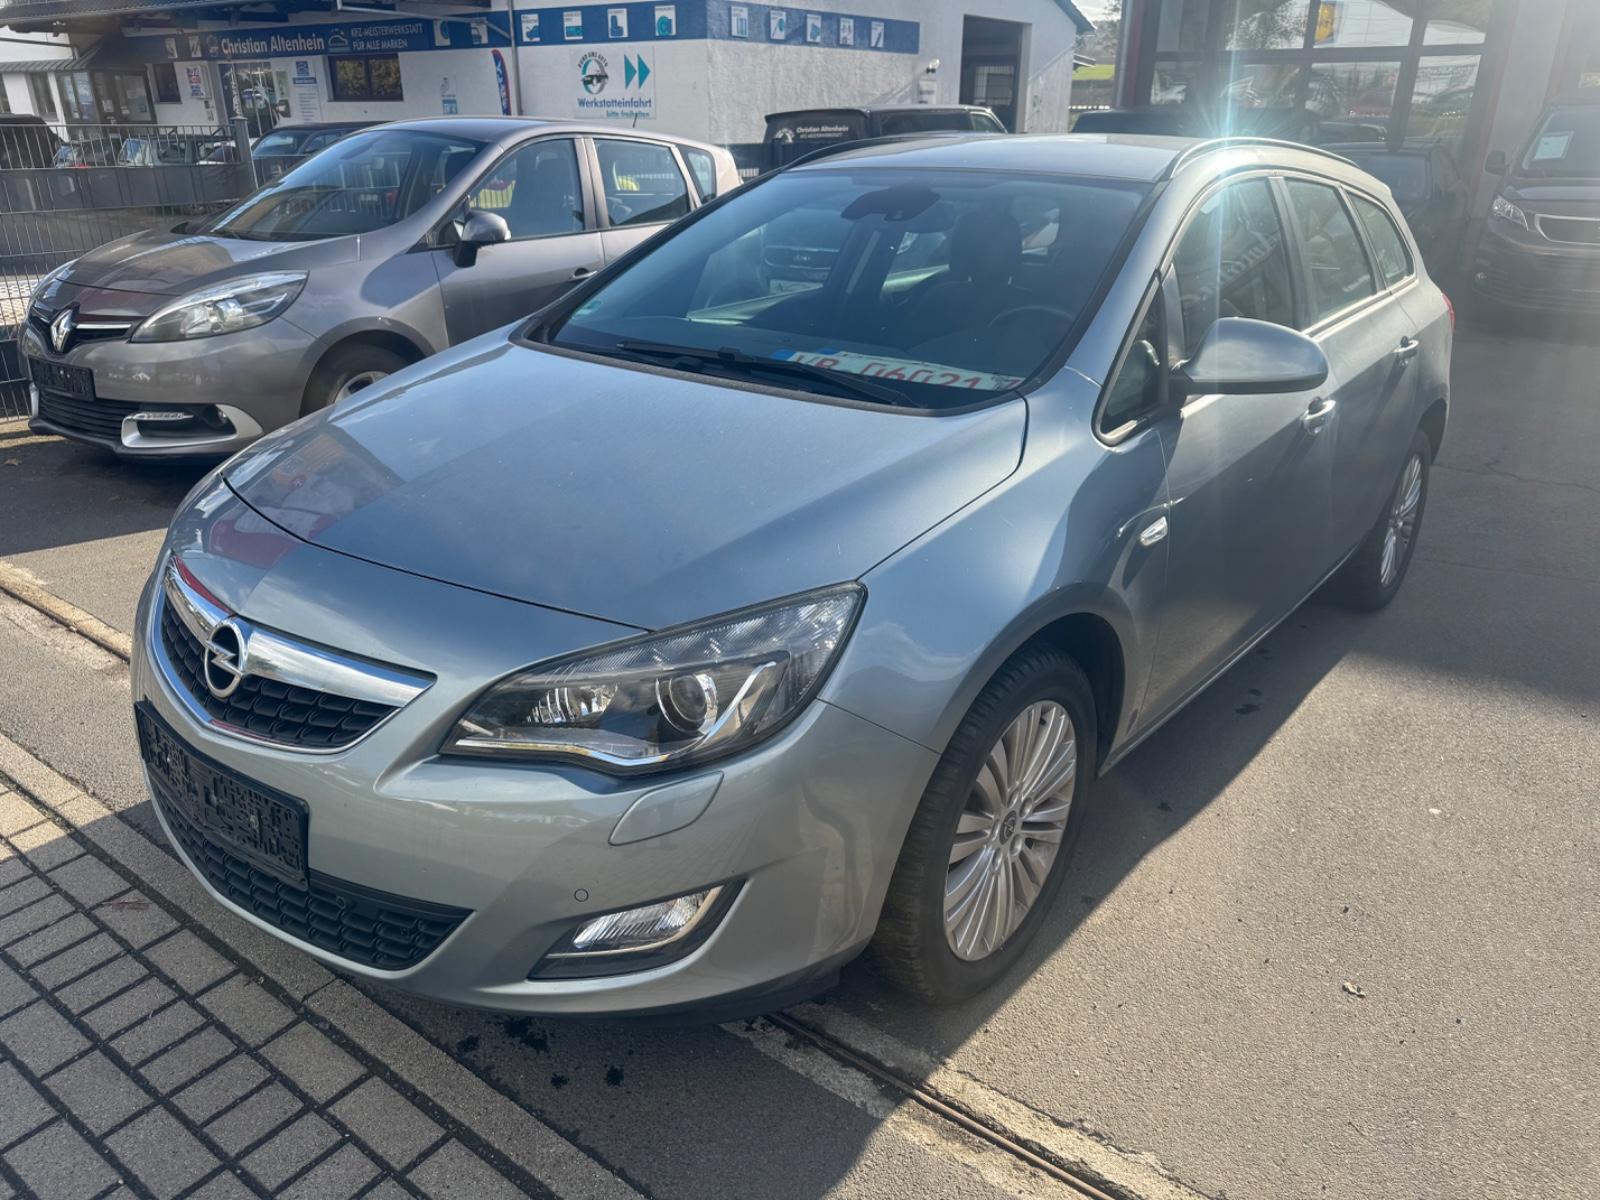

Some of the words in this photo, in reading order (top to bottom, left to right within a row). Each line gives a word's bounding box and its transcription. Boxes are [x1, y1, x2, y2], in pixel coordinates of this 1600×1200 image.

[221, 38, 268, 54] Christian
[271, 33, 325, 52] Altenhein
[577, 97, 652, 108] Werkstatteinfahrt
